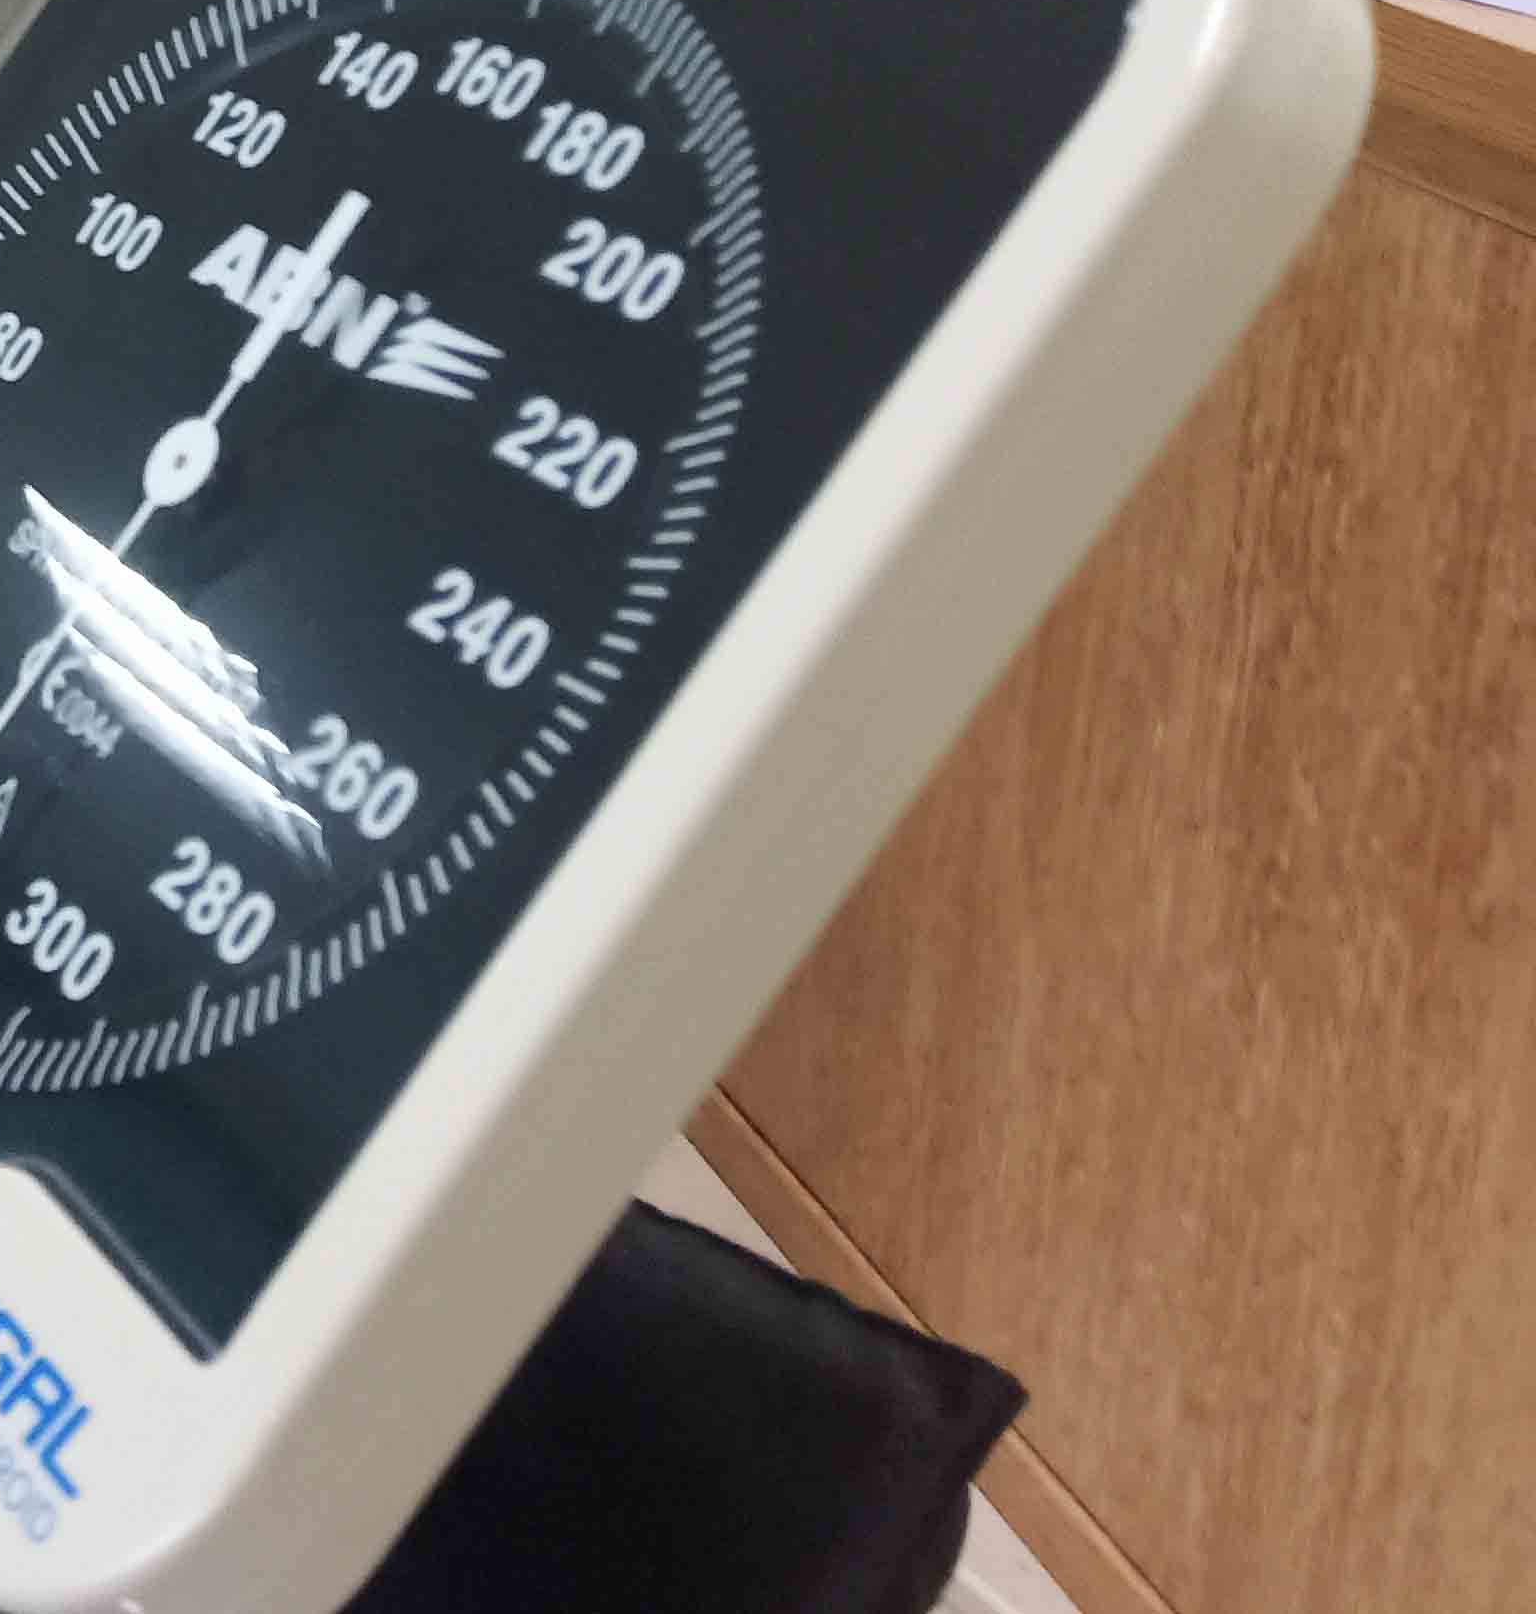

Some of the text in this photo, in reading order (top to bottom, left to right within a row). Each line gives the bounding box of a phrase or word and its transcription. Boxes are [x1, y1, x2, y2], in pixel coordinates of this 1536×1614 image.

[319, 31, 419, 110] 140
[436, 37, 546, 120] 160
[193, 90, 287, 168] 120
[524, 101, 645, 191] 180
[75, 192, 163, 272] 100
[540, 218, 686, 322] 200
[492, 396, 638, 509] 220
[407, 568, 550, 689] 240
[280, 712, 420, 840] 260
[4, 878, 115, 1001] 300
[149, 836, 276, 964] 280
